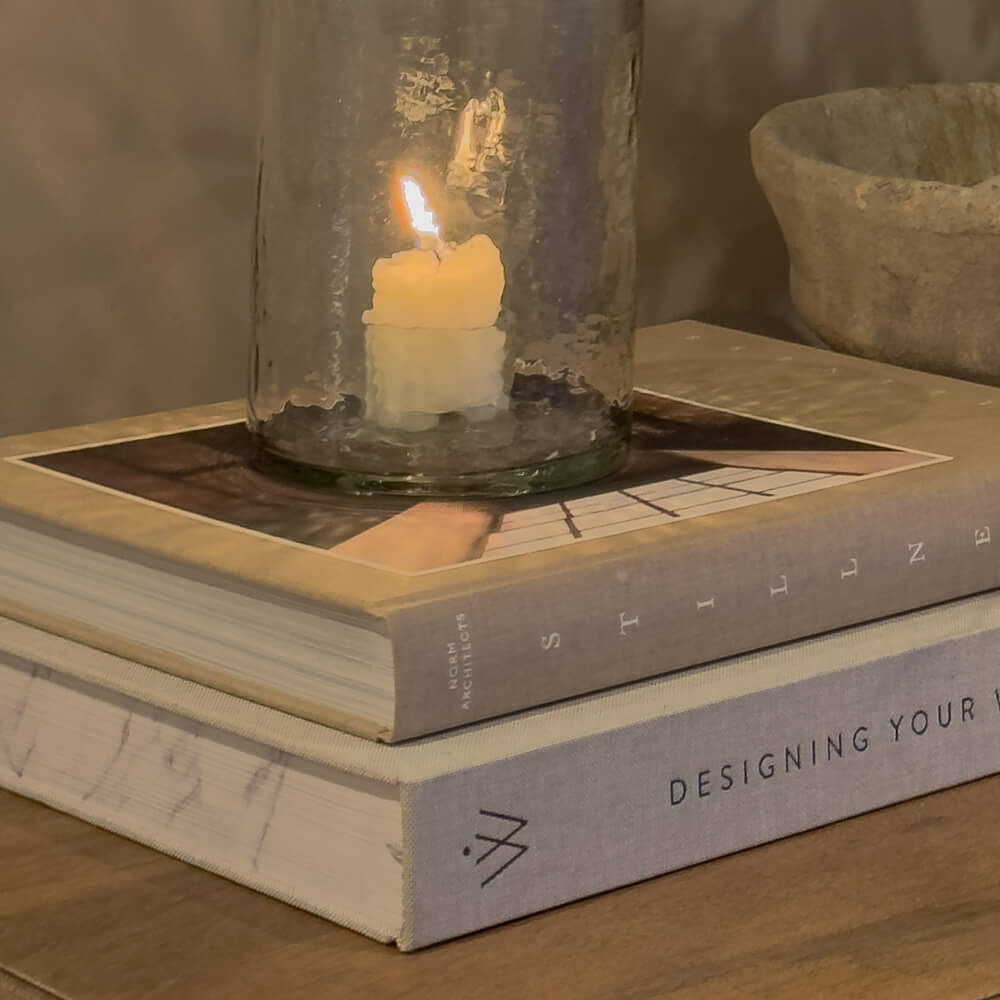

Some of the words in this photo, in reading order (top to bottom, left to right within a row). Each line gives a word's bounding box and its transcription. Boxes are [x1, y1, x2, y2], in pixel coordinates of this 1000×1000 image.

[447, 642, 458, 690] NORM
[456, 613, 472, 710] ARCHITECTS
[669, 726, 869, 806] DESIGNING
[889, 697, 976, 743] YOUR
